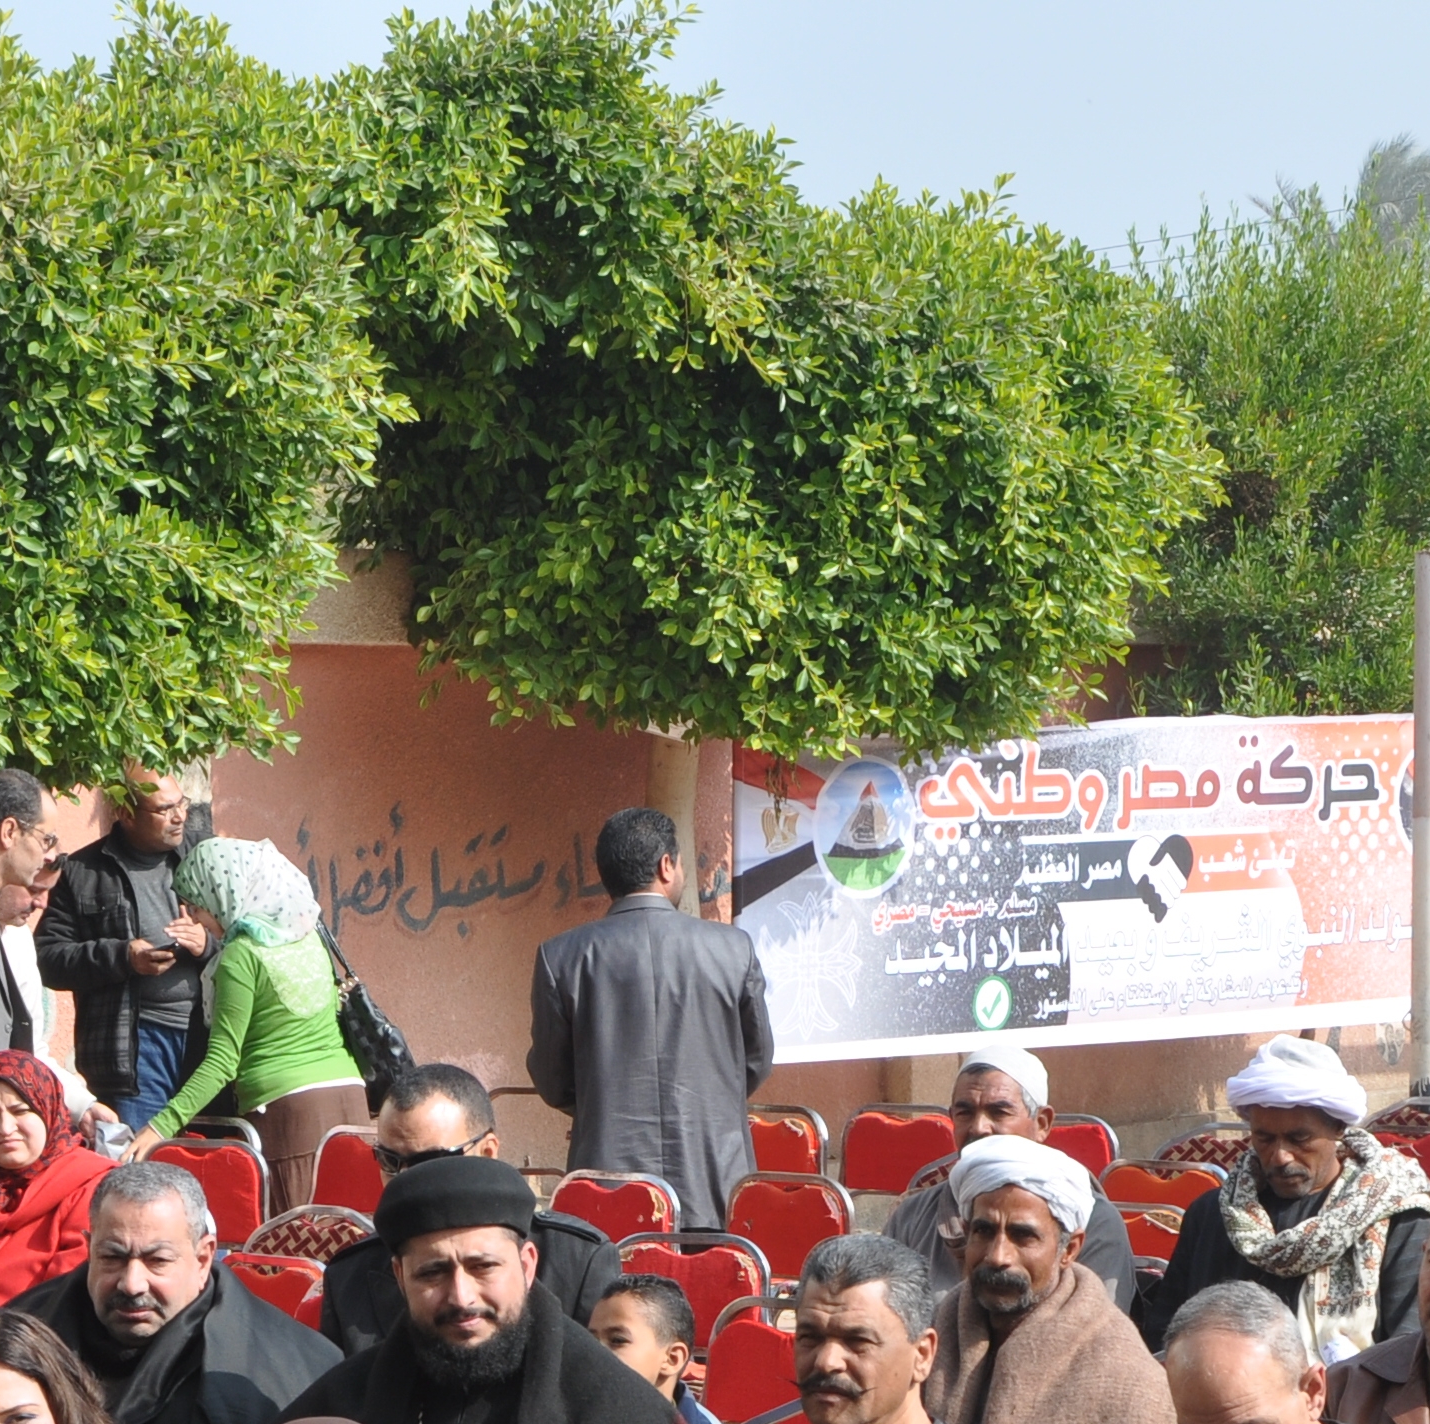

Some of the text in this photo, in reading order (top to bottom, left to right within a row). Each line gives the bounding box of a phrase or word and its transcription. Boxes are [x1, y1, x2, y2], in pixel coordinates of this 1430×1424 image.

[920, 735, 1379, 839] حركة مصر وطني
[397, 825, 545, 938] مستقبل
[1014, 851, 1122, 892] مصر العظيم
[1199, 839, 1246, 880] شعب
[872, 901, 916, 934] مصري
[931, 900, 983, 933] مسيحي
[997, 893, 1038, 919] مسلم
[885, 924, 977, 987] المجيد
[983, 922, 1069, 979] الميلاد
[1162, 904, 1272, 971] الشريف
[1278, 903, 1356, 968] النبوي
